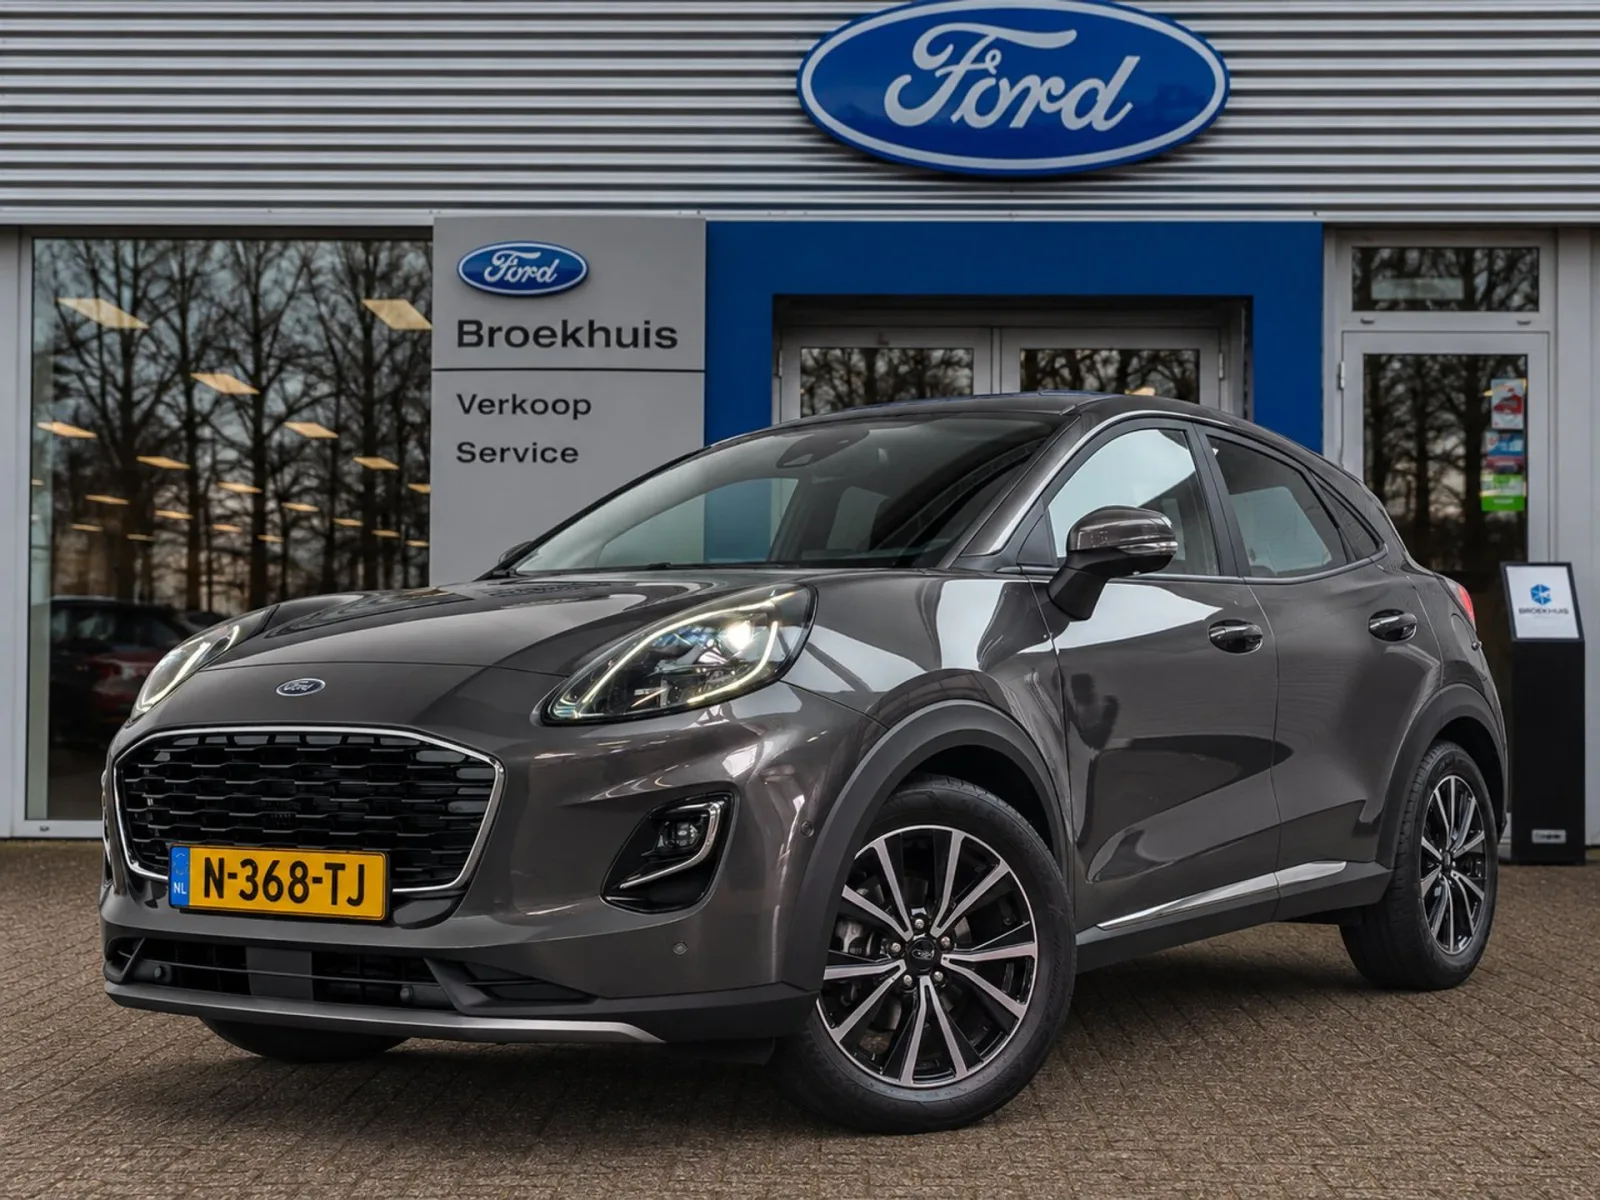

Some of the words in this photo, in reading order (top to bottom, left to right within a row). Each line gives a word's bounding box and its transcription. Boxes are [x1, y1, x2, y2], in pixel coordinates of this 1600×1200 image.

[884, 22, 1140, 131] Ford
[484, 250, 560, 283] Ford
[457, 319, 678, 349] Broekhuis
[456, 393, 592, 420] Verkoop
[456, 441, 579, 463] Service
[283, 680, 315, 691] Ford
[173, 882, 187, 894] NL
[203, 857, 365, 907] N-368-TJ
